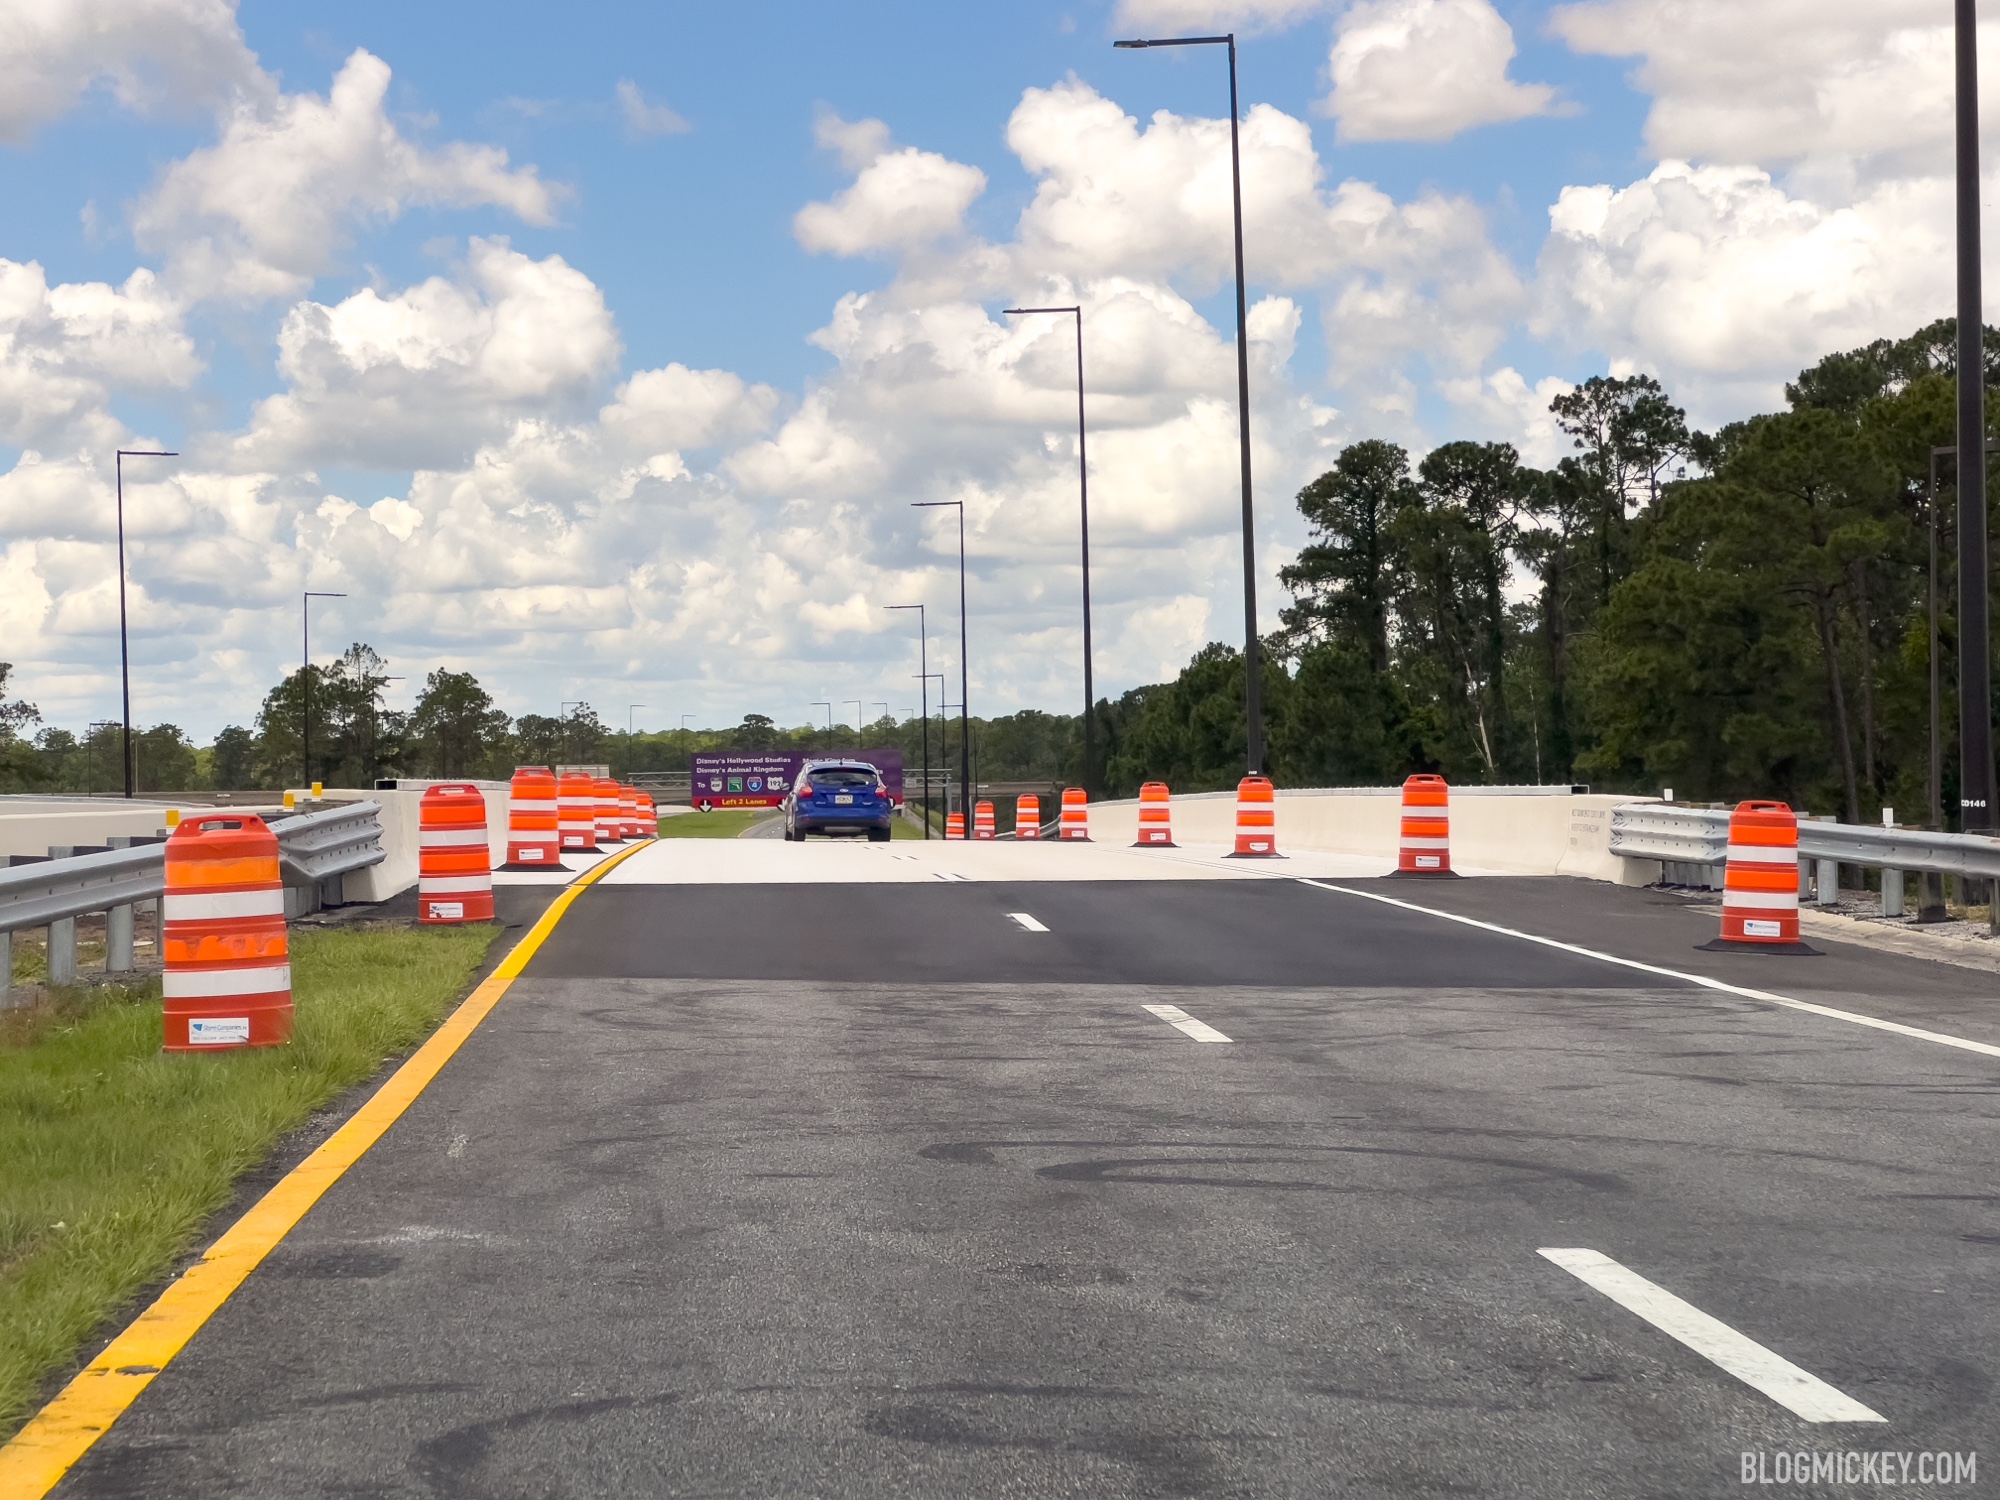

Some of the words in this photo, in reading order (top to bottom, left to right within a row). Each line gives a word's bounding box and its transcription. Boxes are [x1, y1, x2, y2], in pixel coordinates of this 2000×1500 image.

[726, 757, 764, 765] Hollywood
[753, 766, 785, 774] Kingdom
[721, 798, 737, 806] Left
